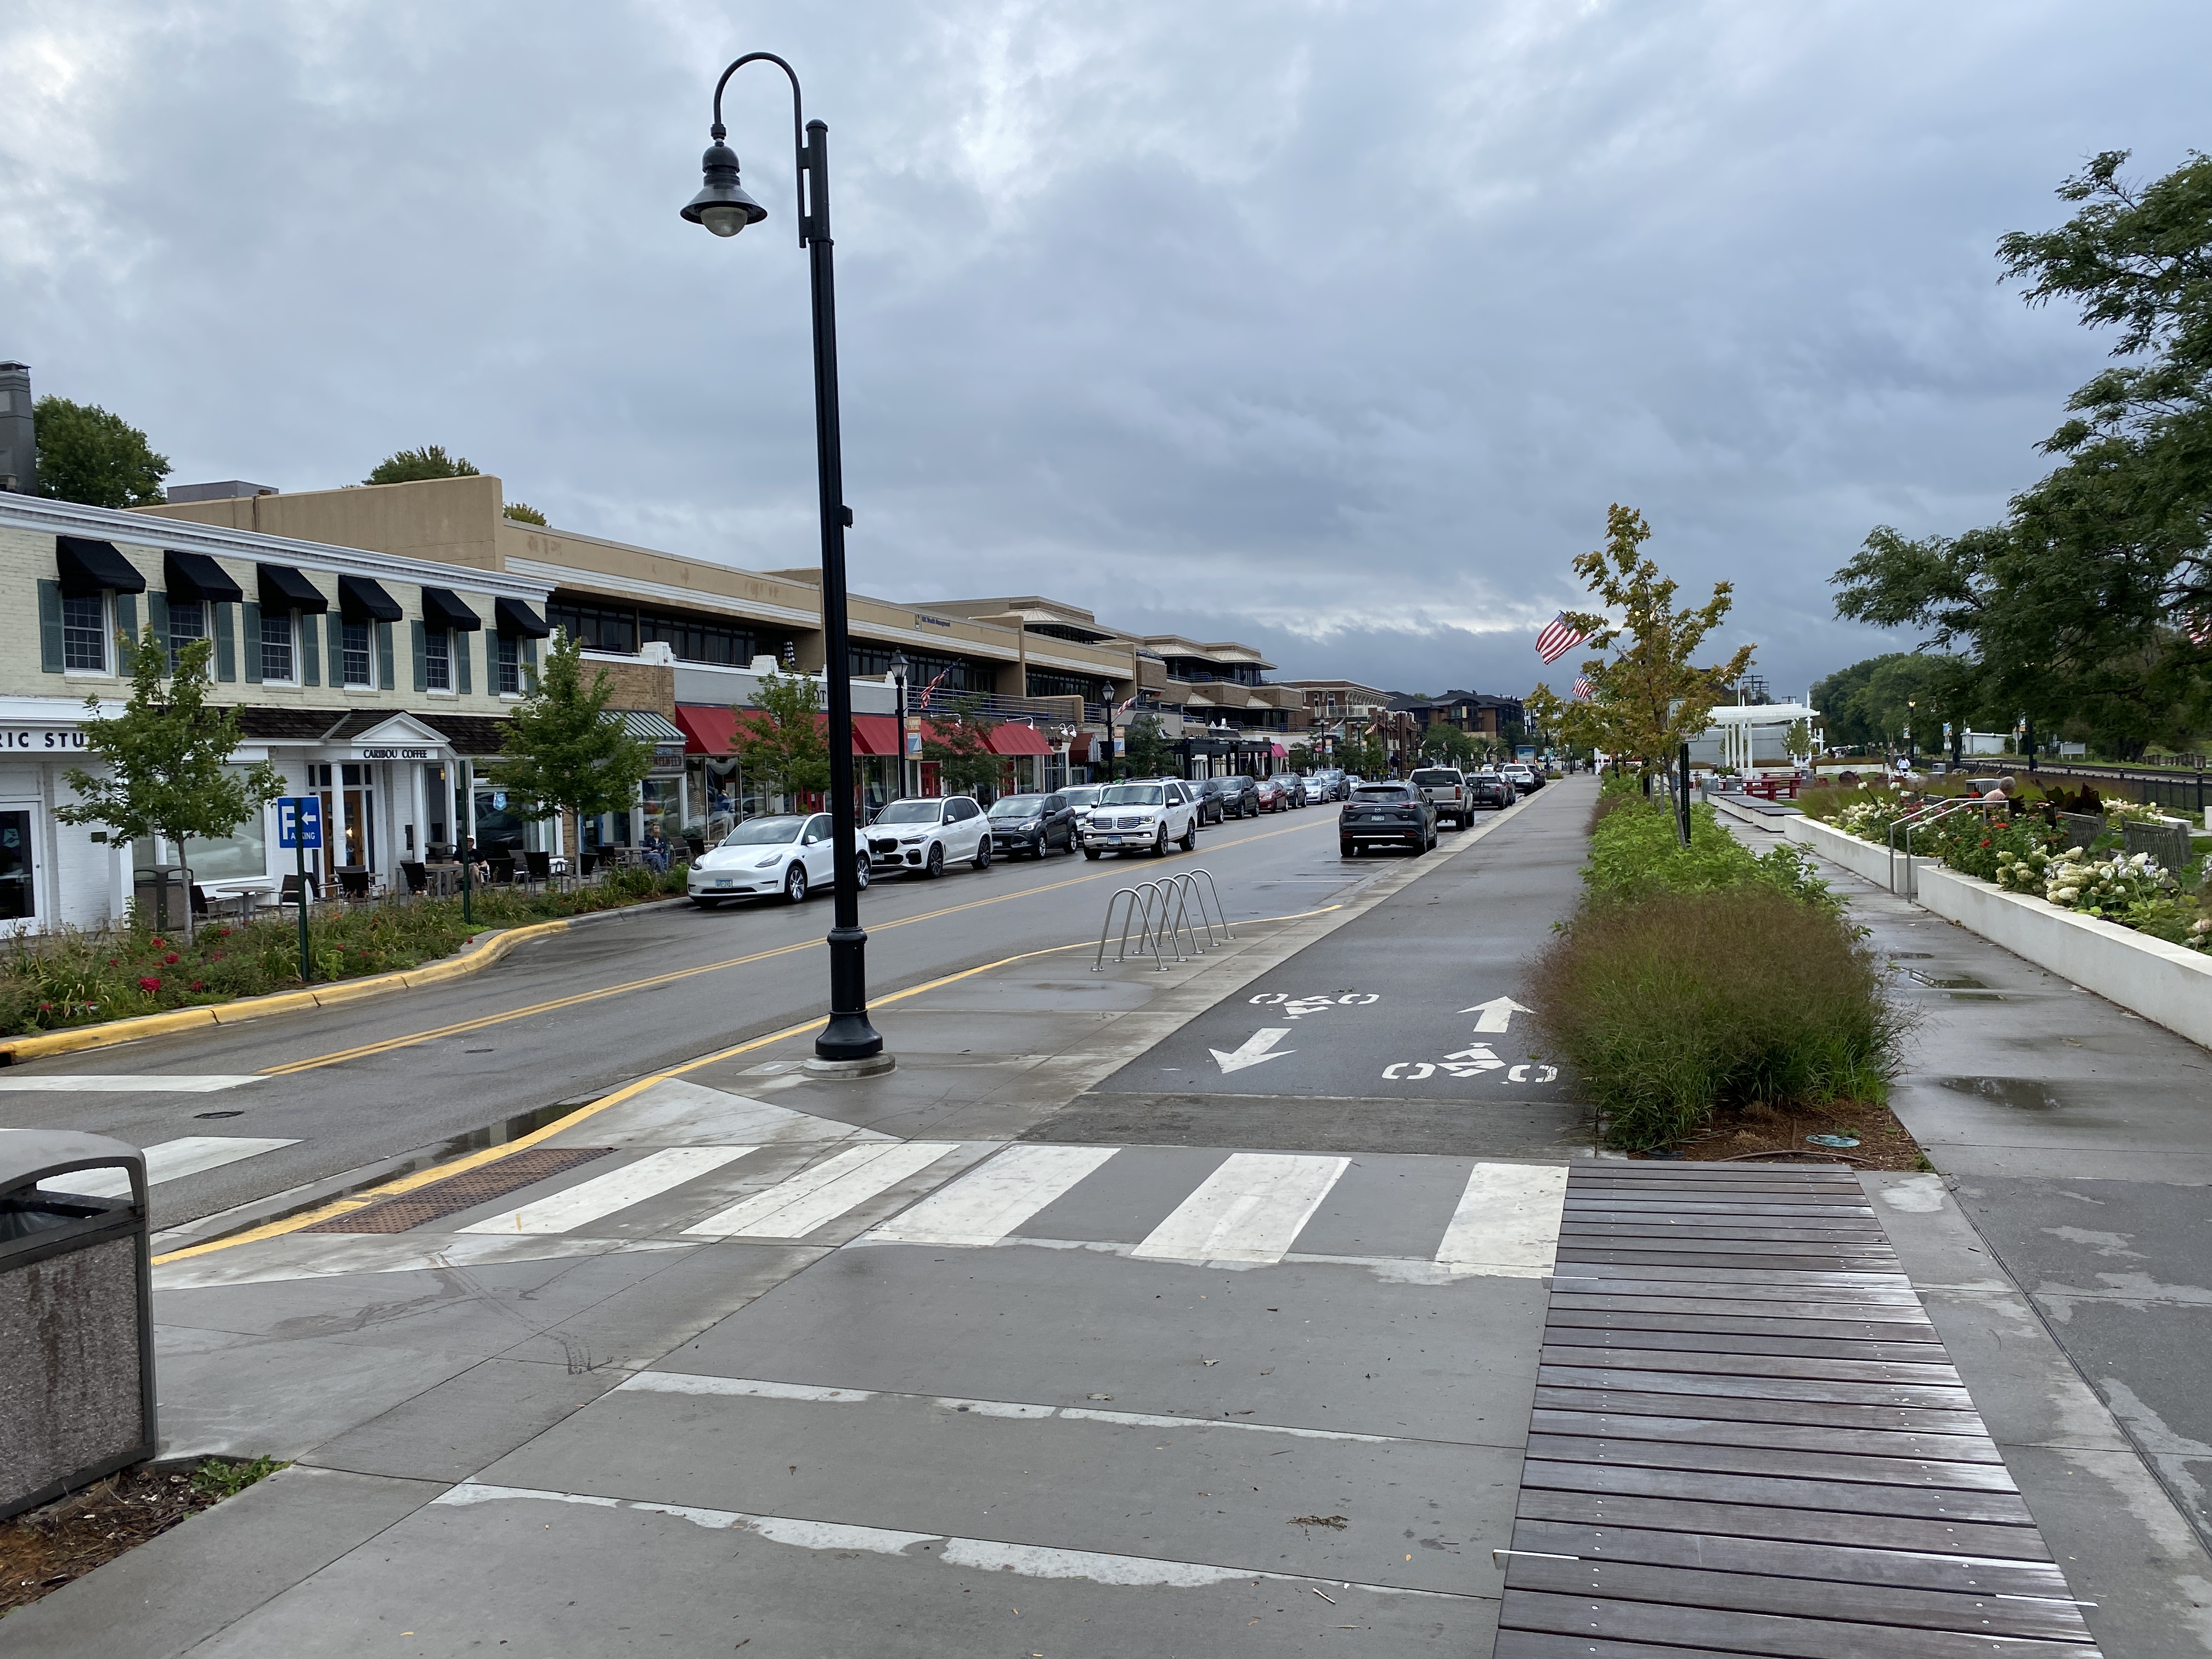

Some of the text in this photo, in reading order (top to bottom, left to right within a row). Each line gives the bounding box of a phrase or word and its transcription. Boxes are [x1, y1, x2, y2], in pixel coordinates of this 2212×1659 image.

[44, 732, 84, 748] STU
[363, 749, 427, 758] CARIBOU COFFEE
